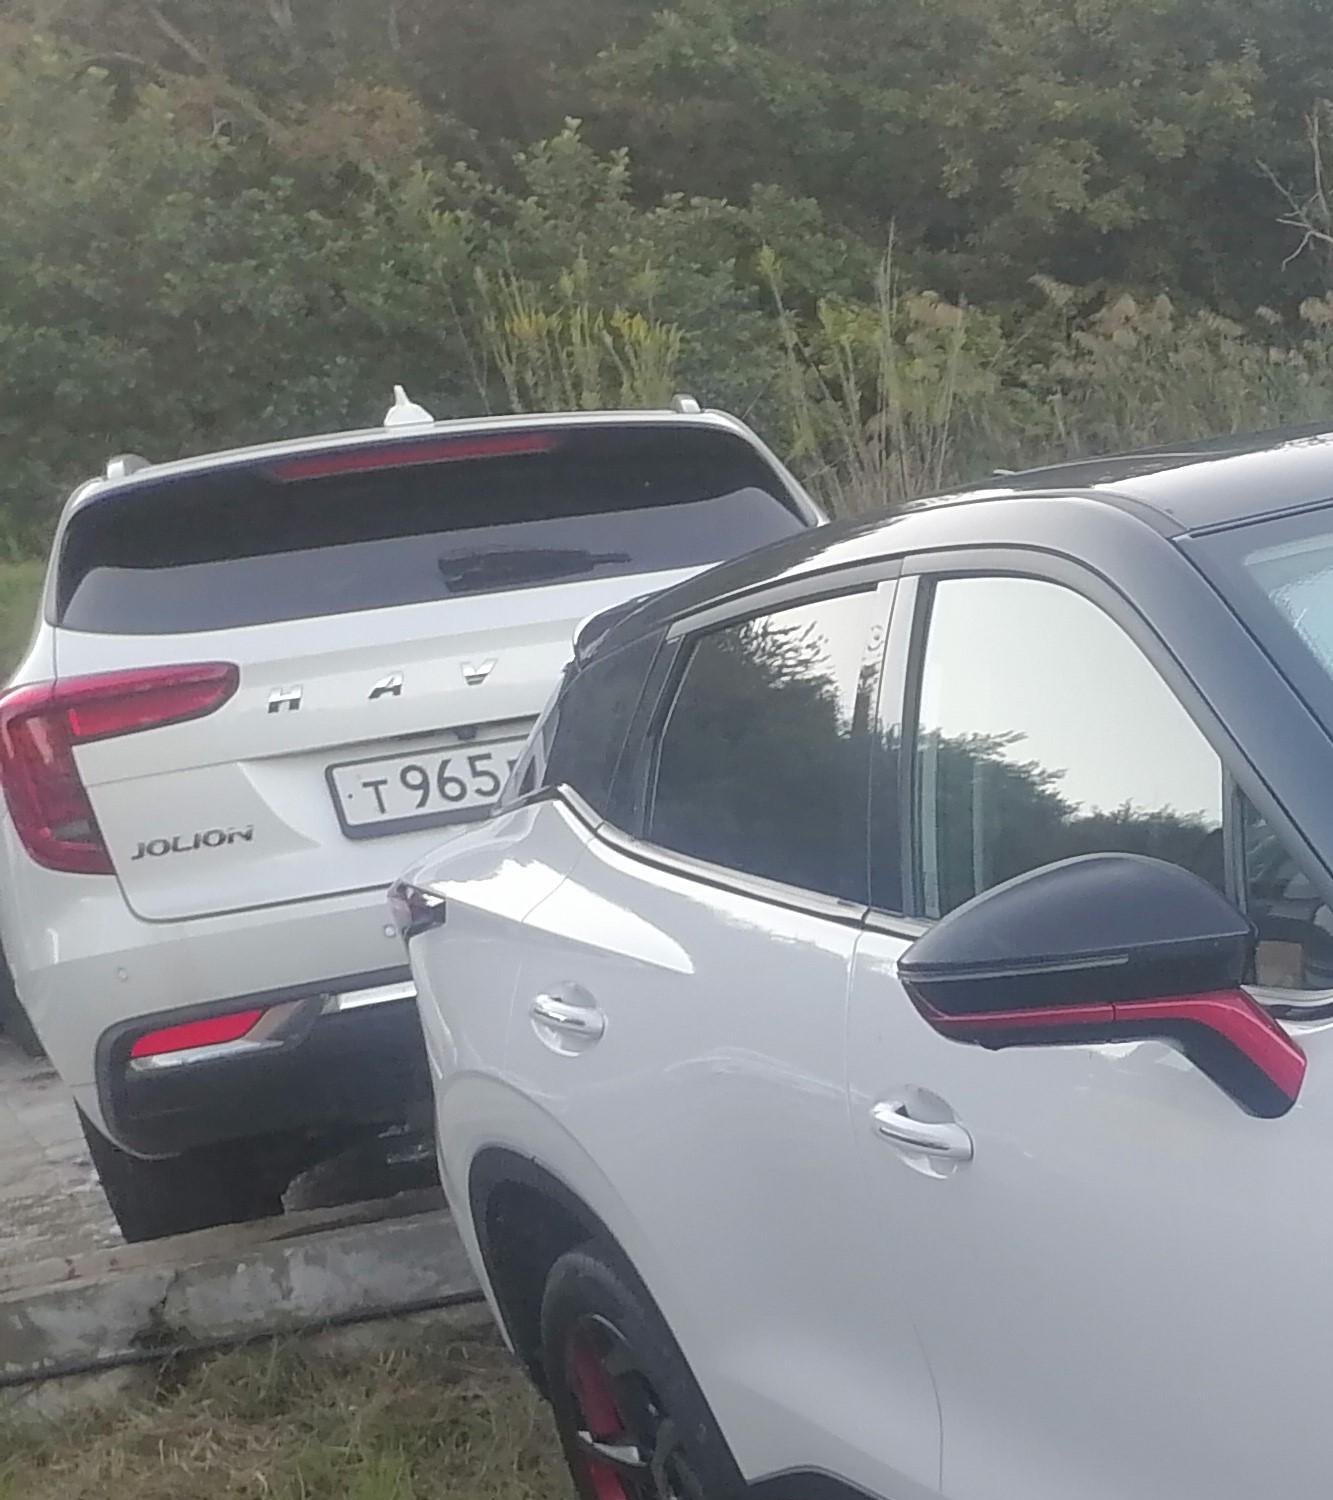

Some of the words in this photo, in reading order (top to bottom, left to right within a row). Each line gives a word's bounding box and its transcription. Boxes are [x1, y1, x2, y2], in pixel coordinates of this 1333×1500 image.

[267, 657, 499, 714] HAV
[361, 752, 519, 815] Т965
[131, 824, 254, 861] JOLION
